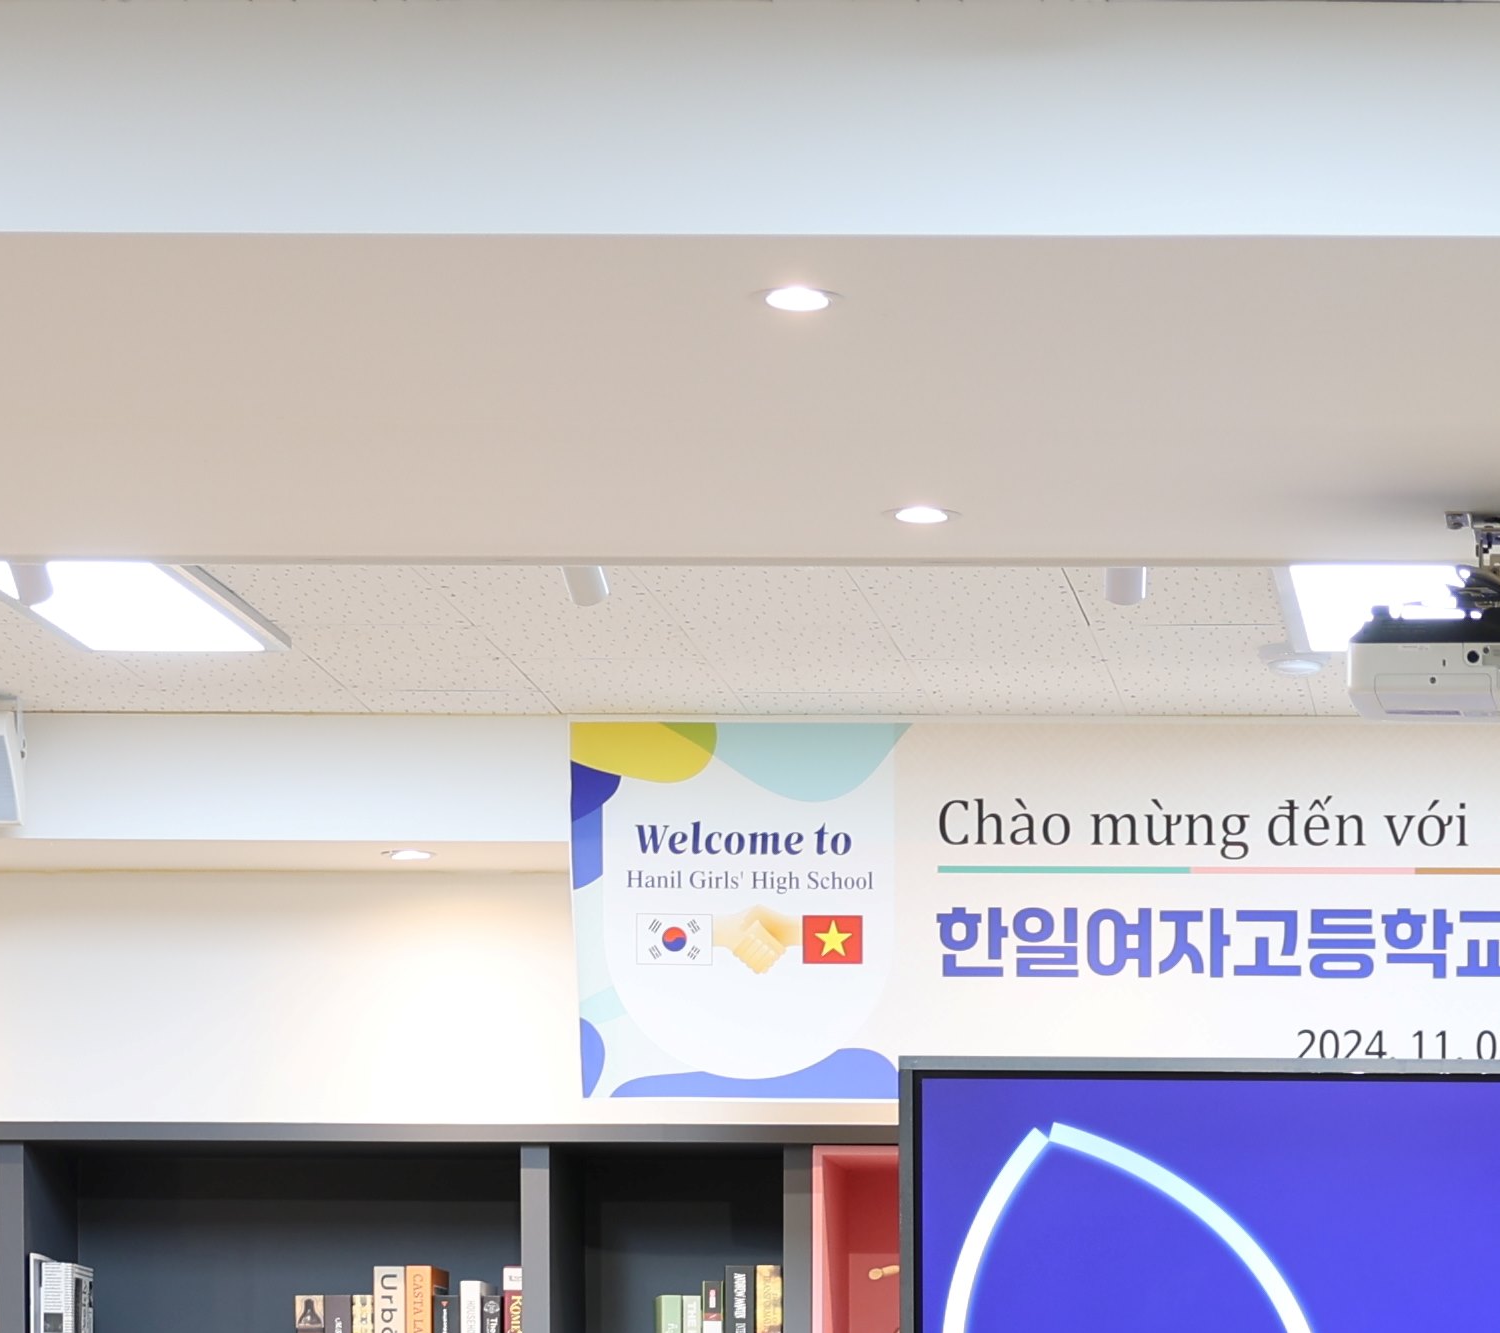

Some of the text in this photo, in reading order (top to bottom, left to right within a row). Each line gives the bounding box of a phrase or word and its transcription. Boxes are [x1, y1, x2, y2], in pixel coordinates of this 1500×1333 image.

[635, 820, 853, 857] Welcome to
[938, 796, 1071, 849] Chào
[1090, 796, 1250, 861] mừng
[1267, 796, 1367, 849] đến
[1386, 800, 1469, 849] với
[626, 868, 876, 898] Hanil Girls' High School
